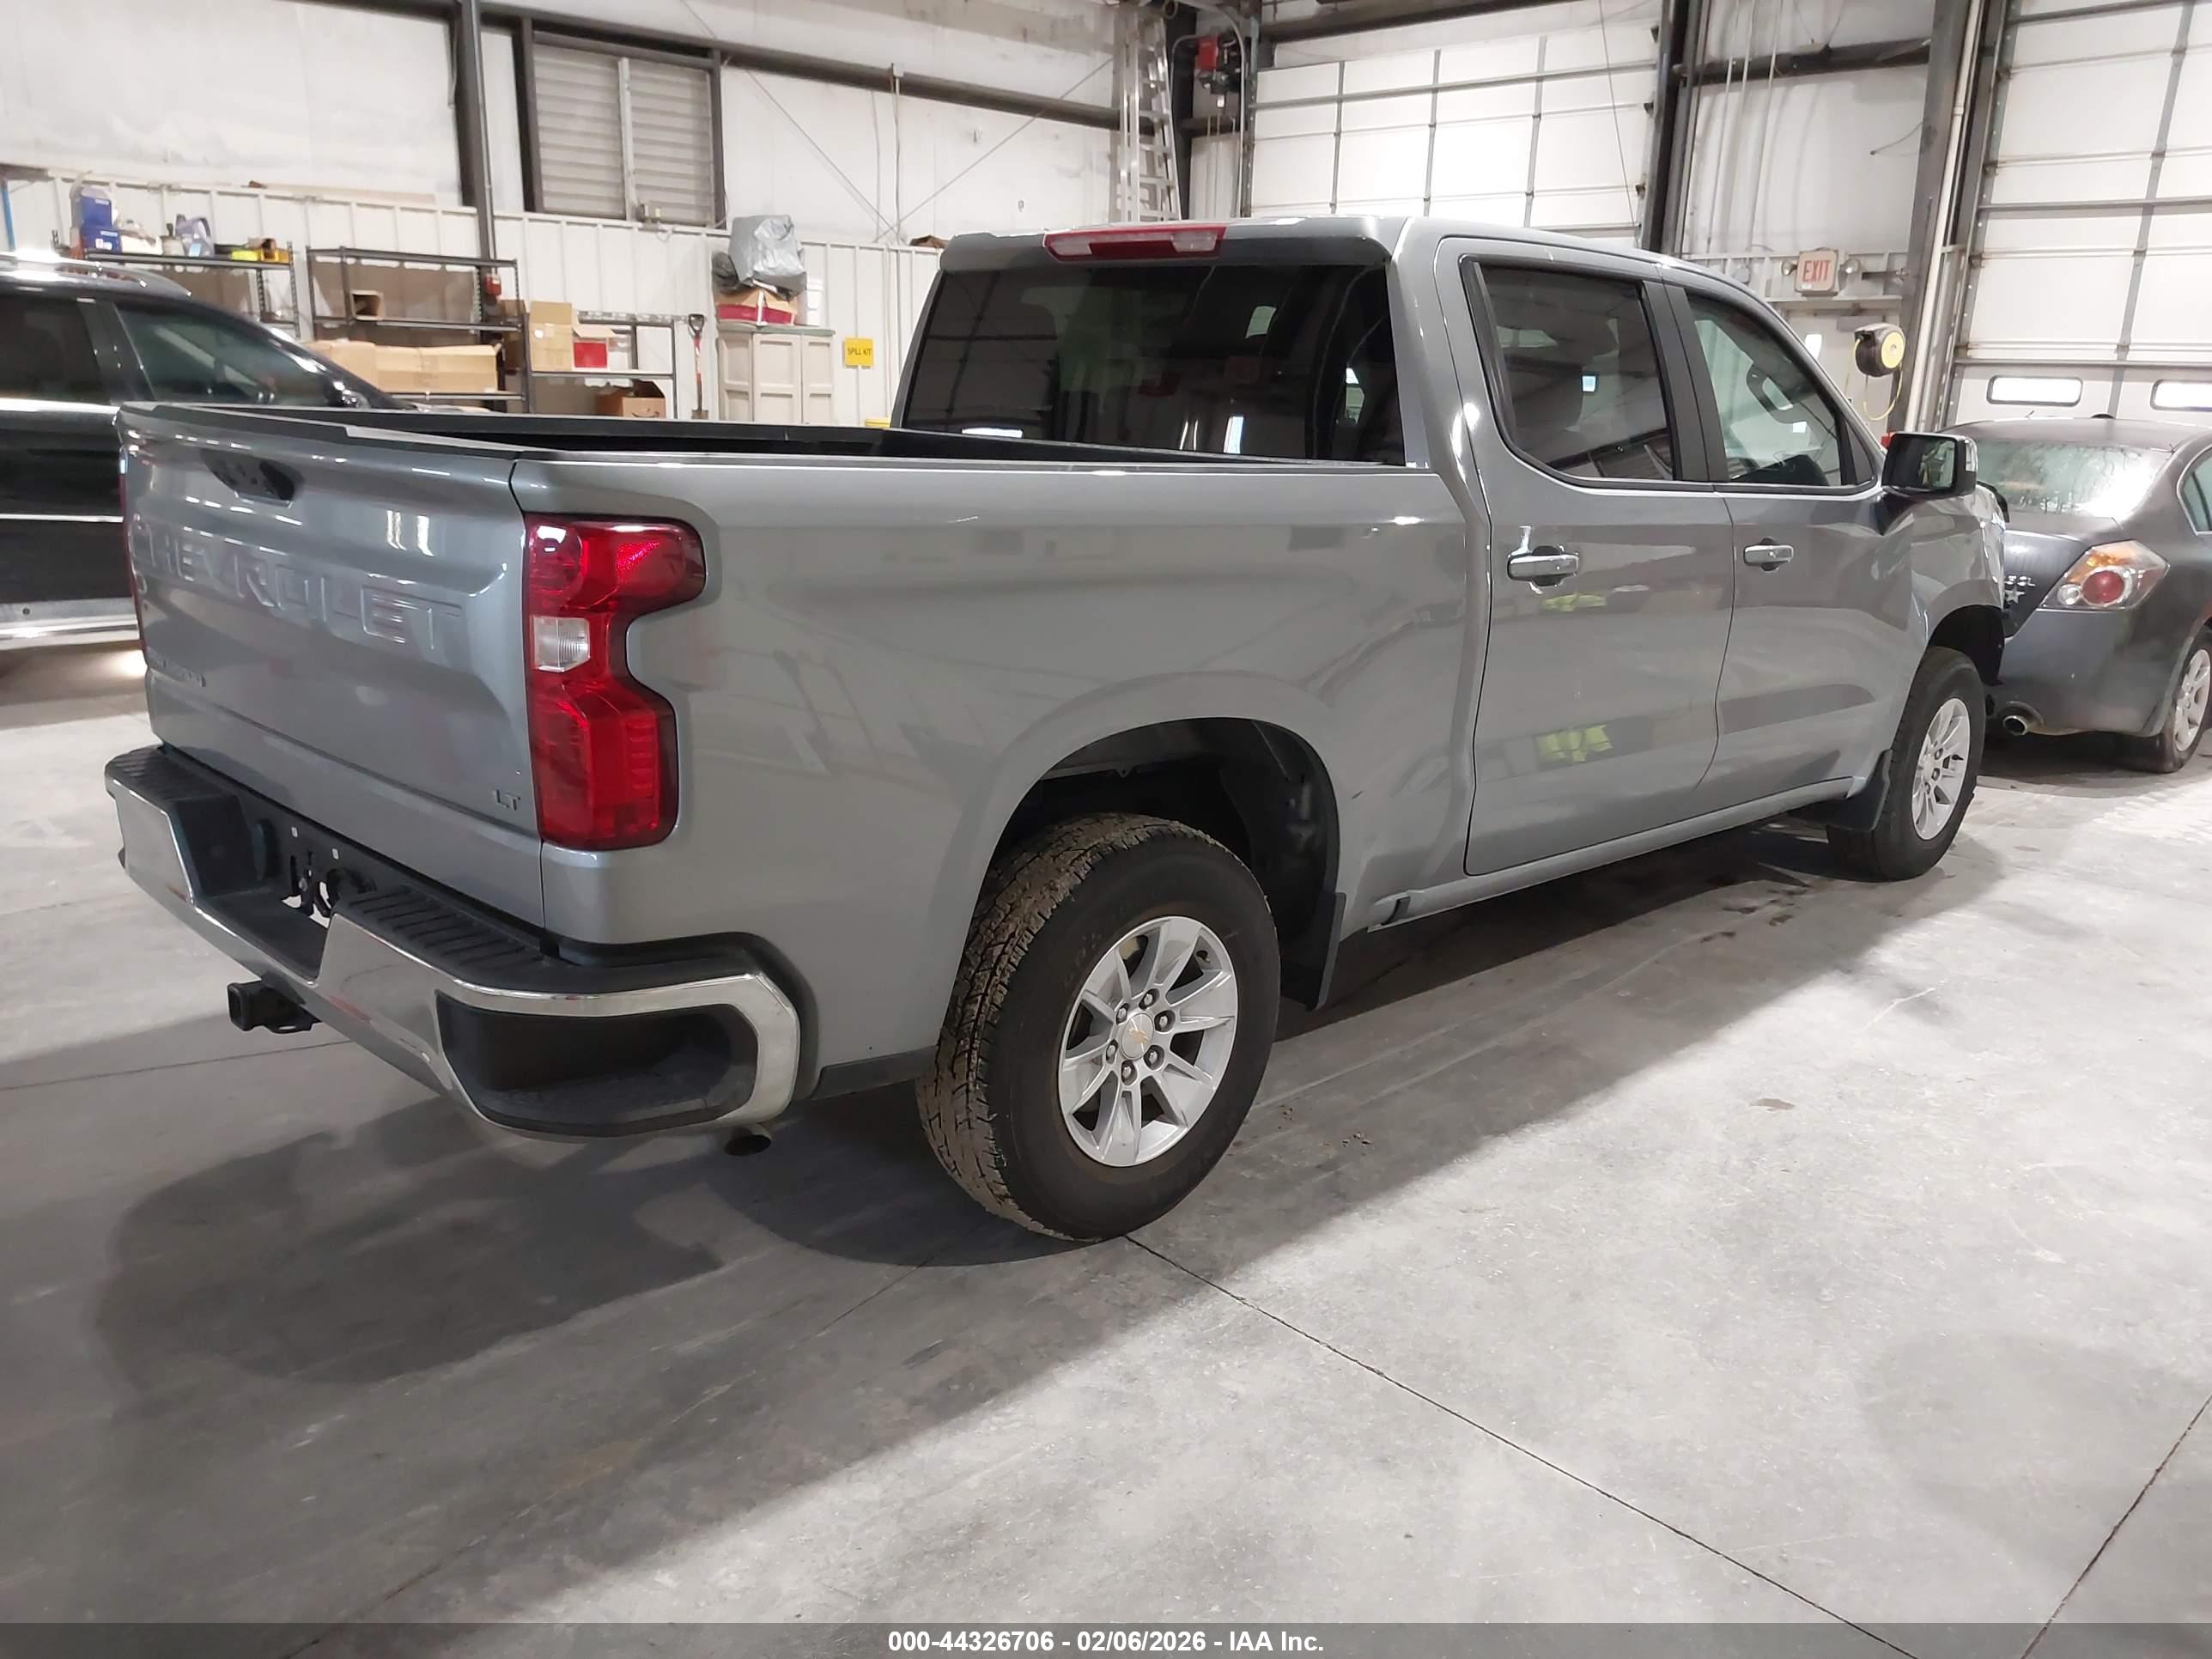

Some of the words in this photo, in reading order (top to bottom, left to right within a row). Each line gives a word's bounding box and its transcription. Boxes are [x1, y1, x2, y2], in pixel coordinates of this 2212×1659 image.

[1802, 260, 1831, 282] EXIT
[847, 347, 861, 356] SPILL
[862, 348, 872, 356] KIT
[127, 514, 463, 651] CHEVROLET
[495, 788, 521, 811] LT
